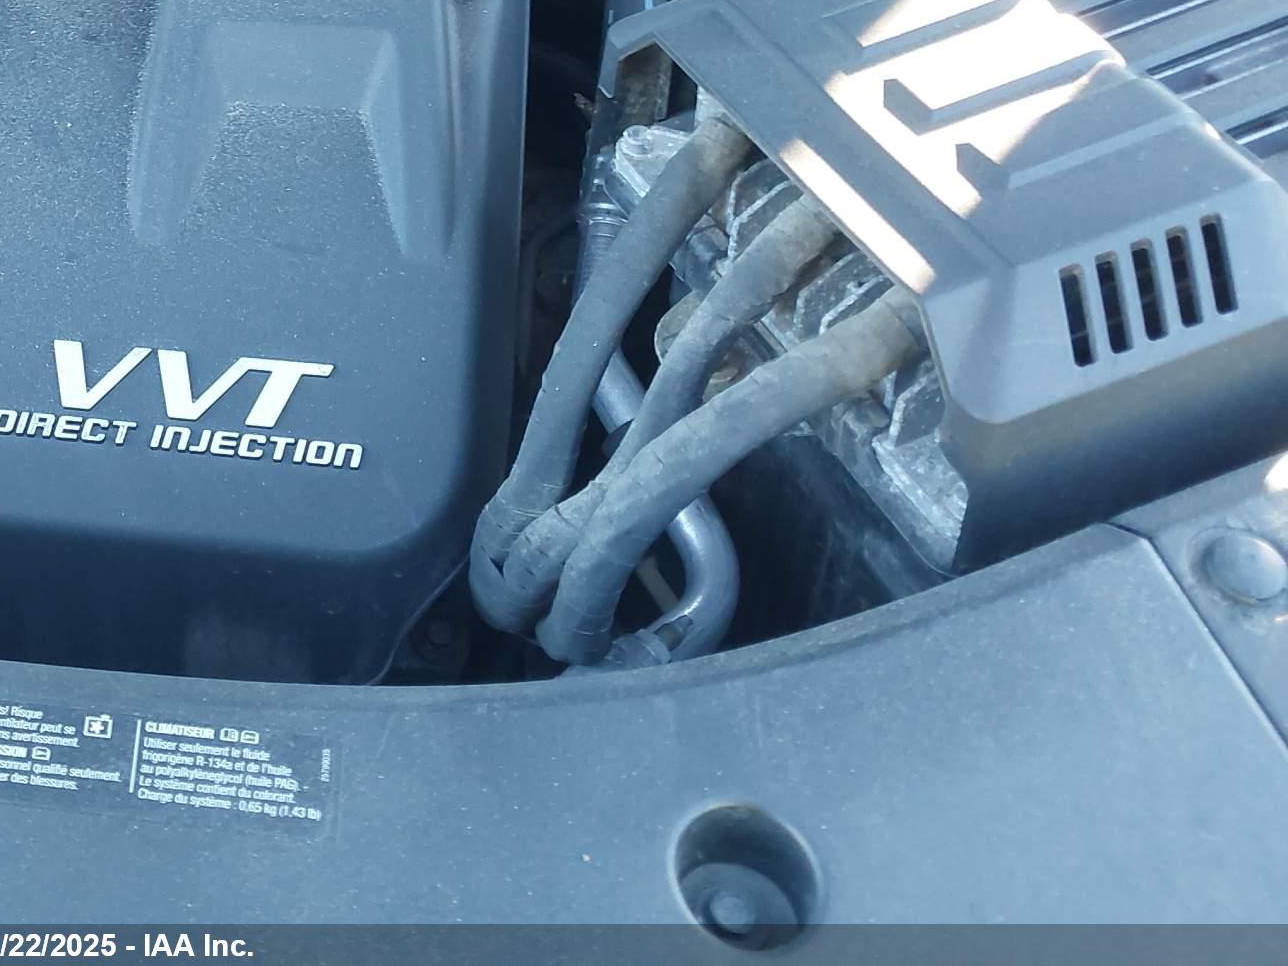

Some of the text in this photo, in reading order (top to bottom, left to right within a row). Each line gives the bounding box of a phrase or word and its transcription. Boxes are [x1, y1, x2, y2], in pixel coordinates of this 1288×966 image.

[54, 340, 334, 428] VVT
[150, 425, 363, 468] INJECTION
[11, 706, 43, 720] Risque
[40, 723, 62, 734] peut
[64, 727, 76, 735] se
[145, 722, 215, 740] CLIMATISEUR
[144, 737, 271, 761] Utiliser seulement le fluide
[195, 757, 233, 770] R-134a
[234, 763, 246, 772] et
[247, 764, 260, 773] de
[11, 773, 28, 784] des
[69, 768, 122, 783] seulement.
[140, 766, 153, 775] au
[245, 775, 272, 788] (huile
[139, 776, 152, 787] Le
[196, 784, 237, 797] contient
[238, 788, 252, 799] du
[253, 790, 296, 804] colorant.
[138, 788, 173, 803] Charge
[174, 793, 188, 805] du
[264, 804, 277, 818] kg
